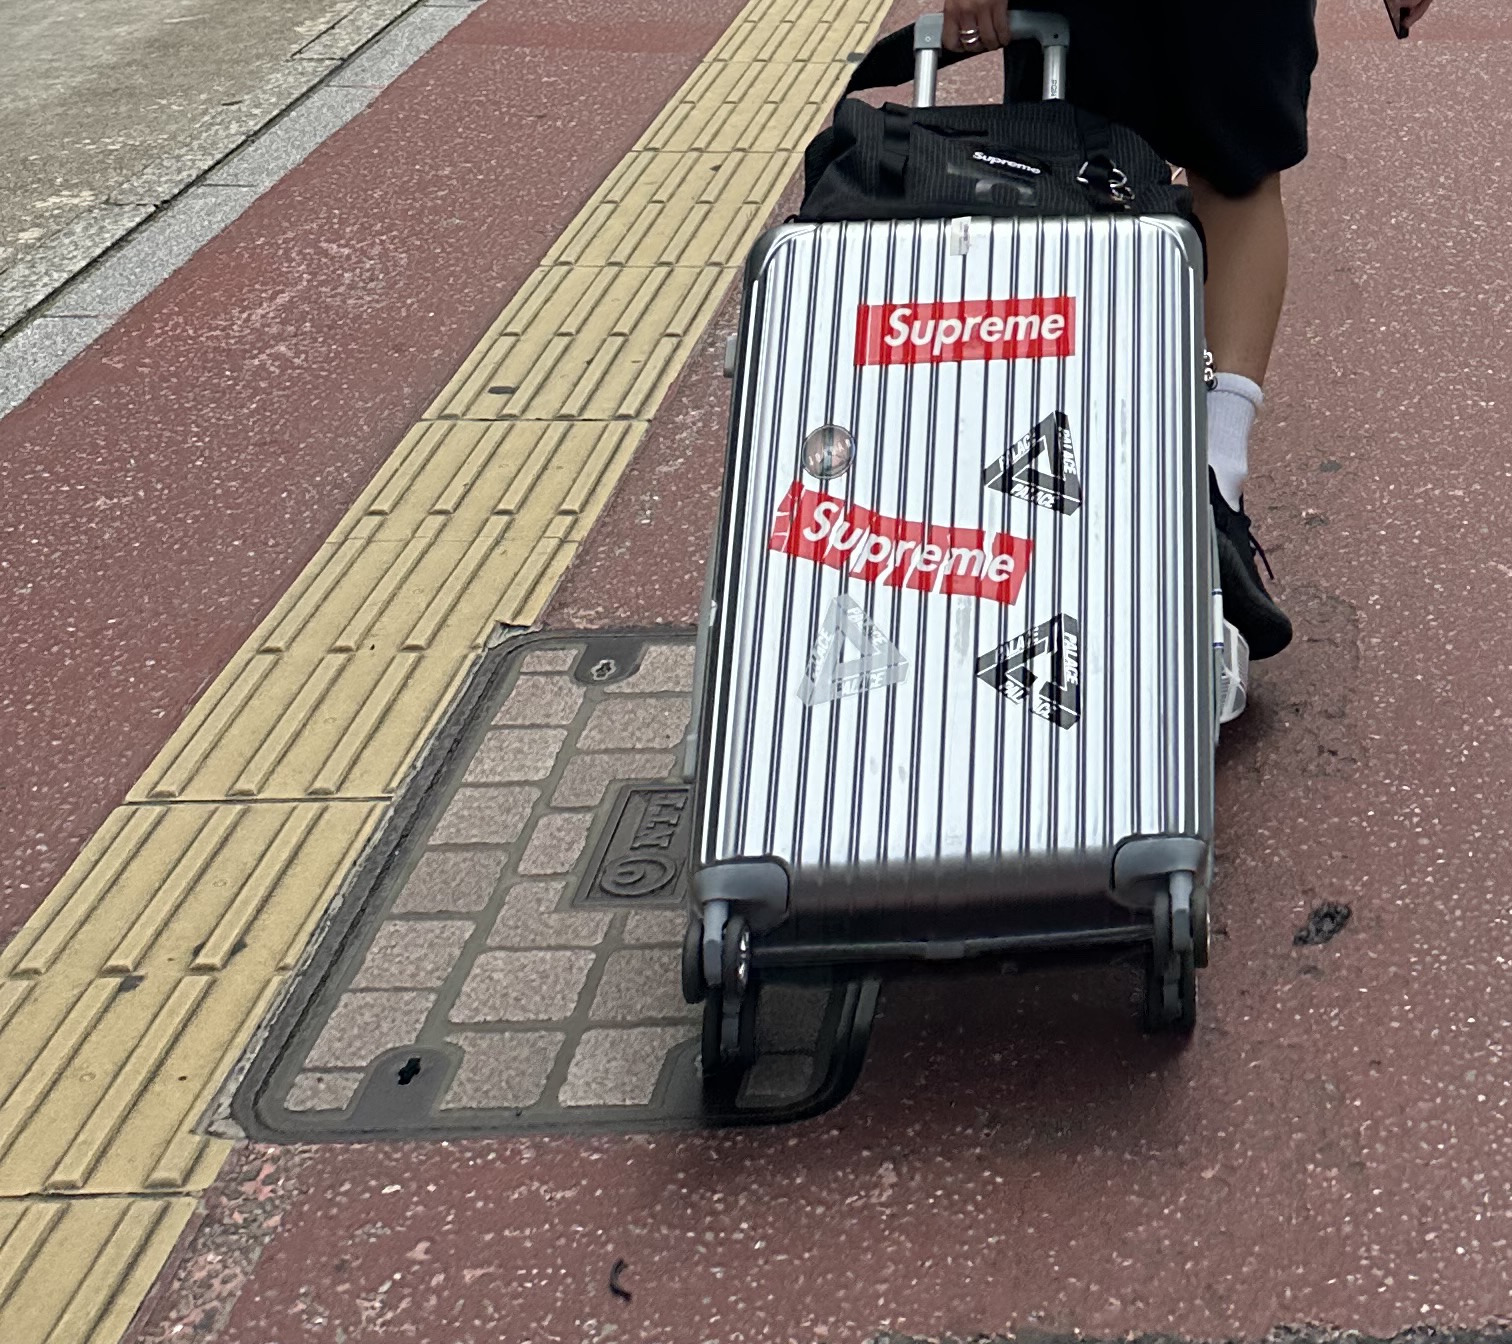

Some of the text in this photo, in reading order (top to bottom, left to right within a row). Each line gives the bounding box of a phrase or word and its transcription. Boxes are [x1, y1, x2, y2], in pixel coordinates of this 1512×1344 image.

[973, 151, 1041, 174] Supreme
[884, 308, 1065, 355] Supreme
[803, 501, 1015, 583] Supreme
[1063, 632, 1079, 685] PALACE
